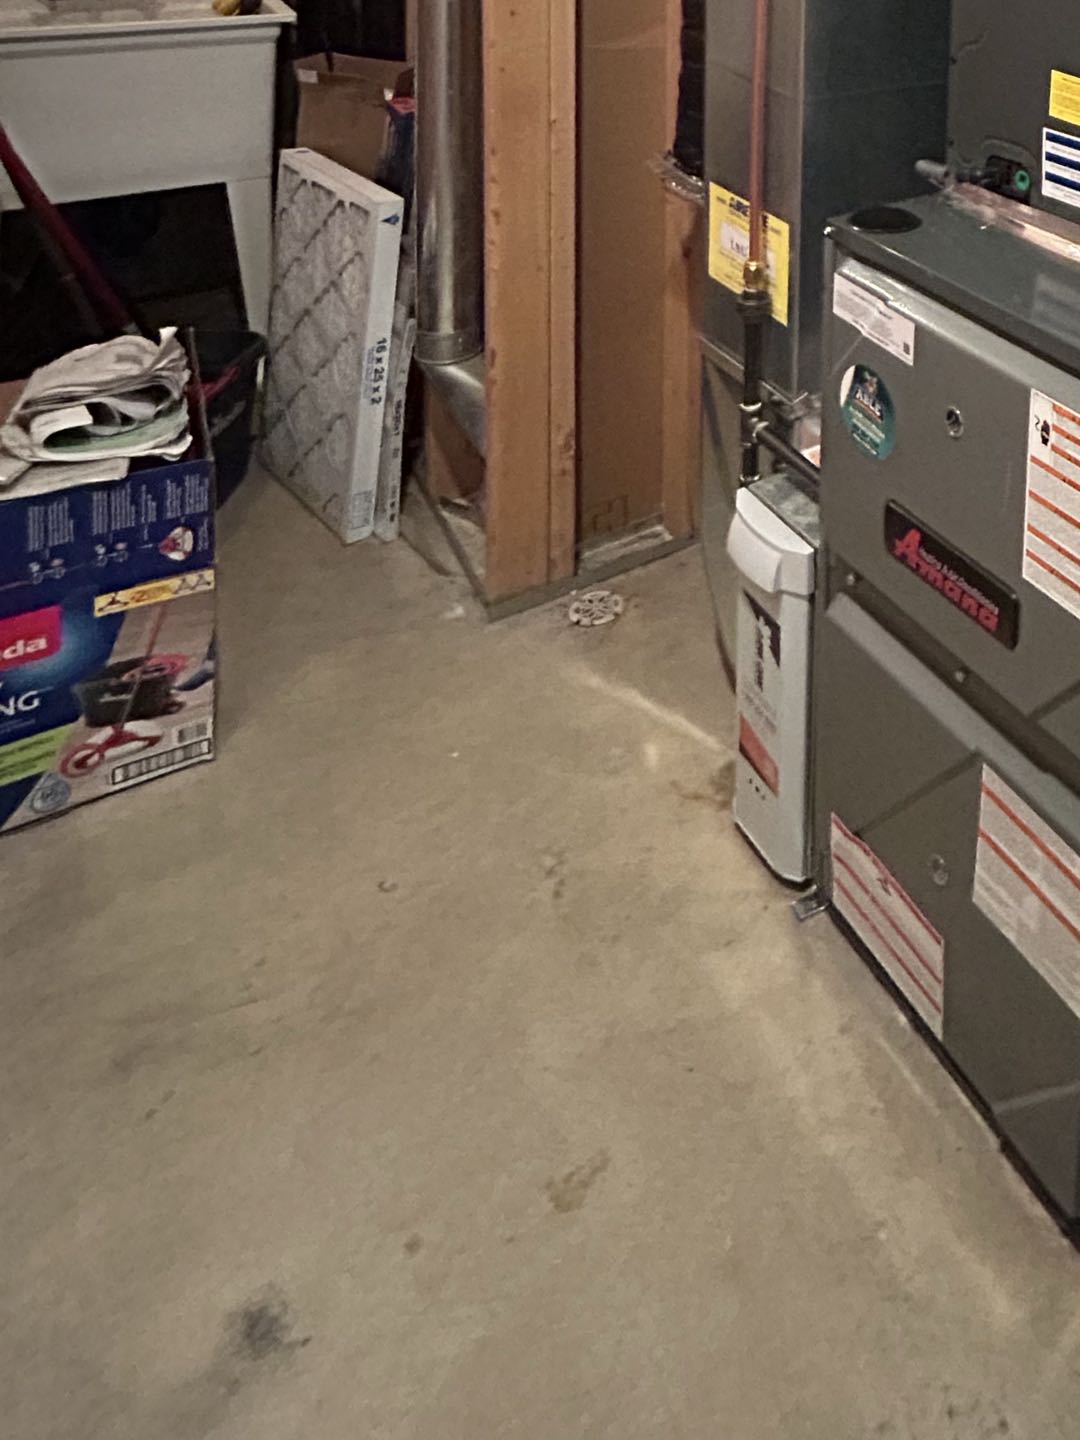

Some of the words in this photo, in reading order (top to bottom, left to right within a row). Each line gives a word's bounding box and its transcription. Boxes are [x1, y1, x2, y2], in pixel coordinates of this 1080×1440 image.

[376, 338, 387, 353] 16
[374, 367, 385, 382] 25
[371, 397, 382, 405] 2
[894, 528, 1000, 632] Amana
[0, 635, 48, 659] da
